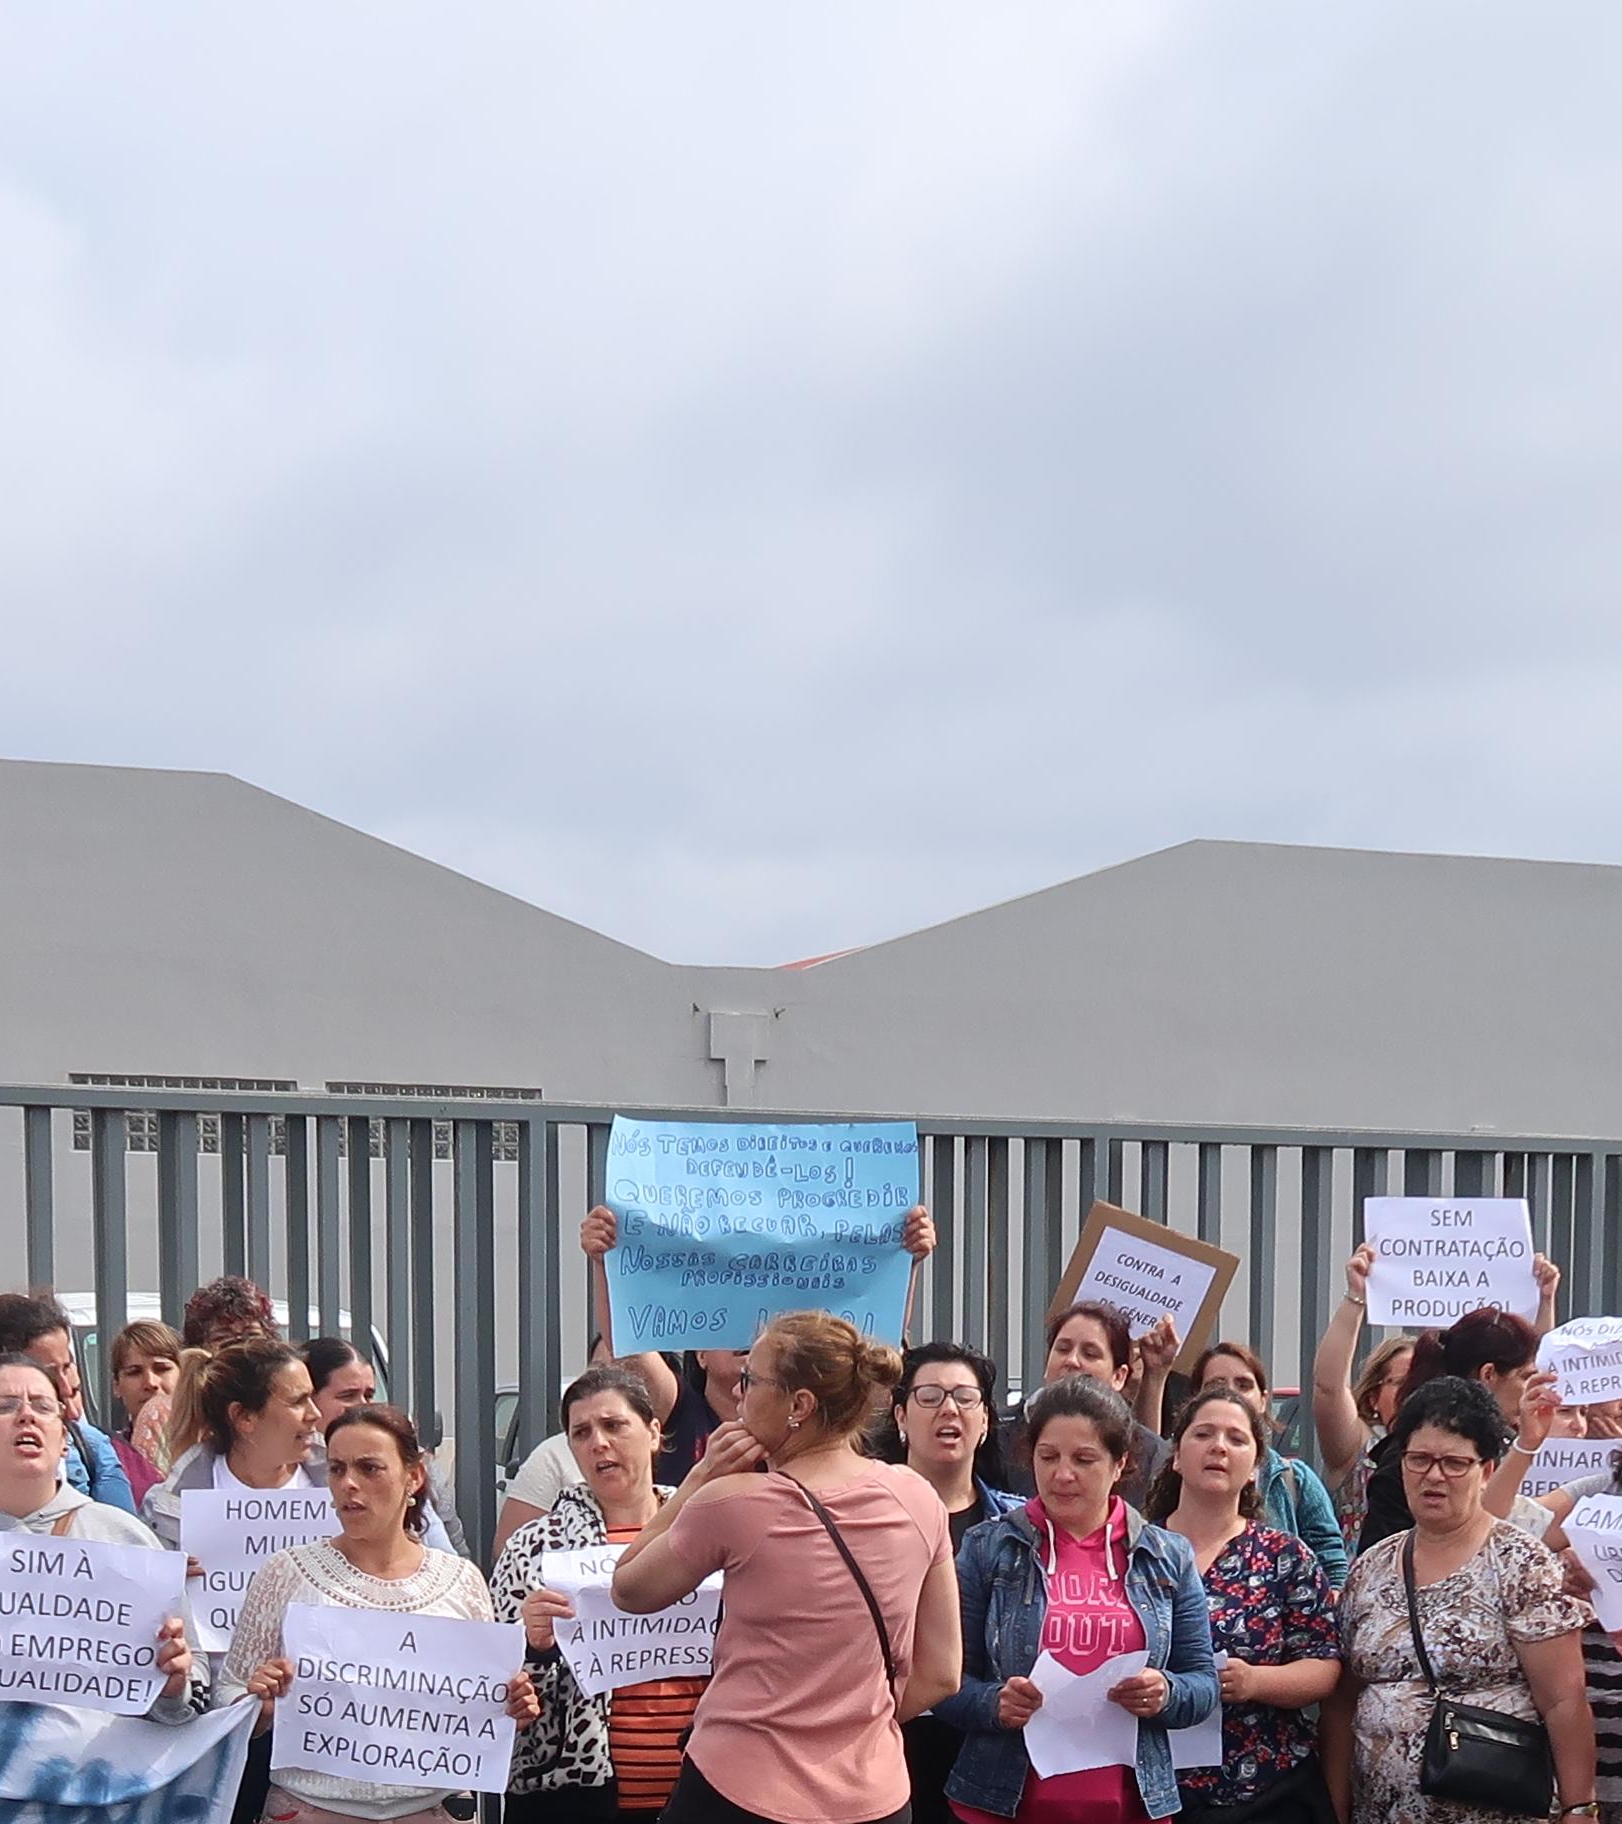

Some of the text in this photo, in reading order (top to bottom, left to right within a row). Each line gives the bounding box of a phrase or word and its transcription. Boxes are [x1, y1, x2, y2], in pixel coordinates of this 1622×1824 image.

[657, 1134, 729, 1155] TEMOS
[614, 1179, 763, 1208] QUEREMOS
[625, 1211, 648, 1236] E
[1430, 1209, 1473, 1227] SEM
[1379, 1236, 1526, 1262] CONTRATAÇÃO
[1116, 1253, 1182, 1286] CONTRA A
[1413, 1269, 1491, 1288] BAIXA A
[1094, 1270, 1184, 1312] DESIGUALDADE
[629, 1304, 728, 1339] VAMOS
[1118, 1306, 1158, 1328] GÉNER
[1560, 1322, 1592, 1337] NÓS
[1564, 1380, 1576, 1397] À
[1536, 1451, 1603, 1469] INHAR
[226, 1500, 327, 1520] HOMEM
[10, 1549, 94, 1580] SIM À
[580, 1554, 618, 1576] NÓ
[399, 1631, 417, 1653] A
[570, 1616, 718, 1646] À INTIMIDAÇ
[1043, 1609, 1134, 1656] OUT
[11, 1634, 155, 1667] EMPREGO
[589, 1652, 604, 1678] À
[610, 1646, 713, 1674] REPRESS
[297, 1657, 509, 1704] DISCRIMINAÇÃO
[298, 1692, 496, 1740] SÓ AUMENTA A
[303, 1731, 482, 1777] EXPLORAÇÃO!
